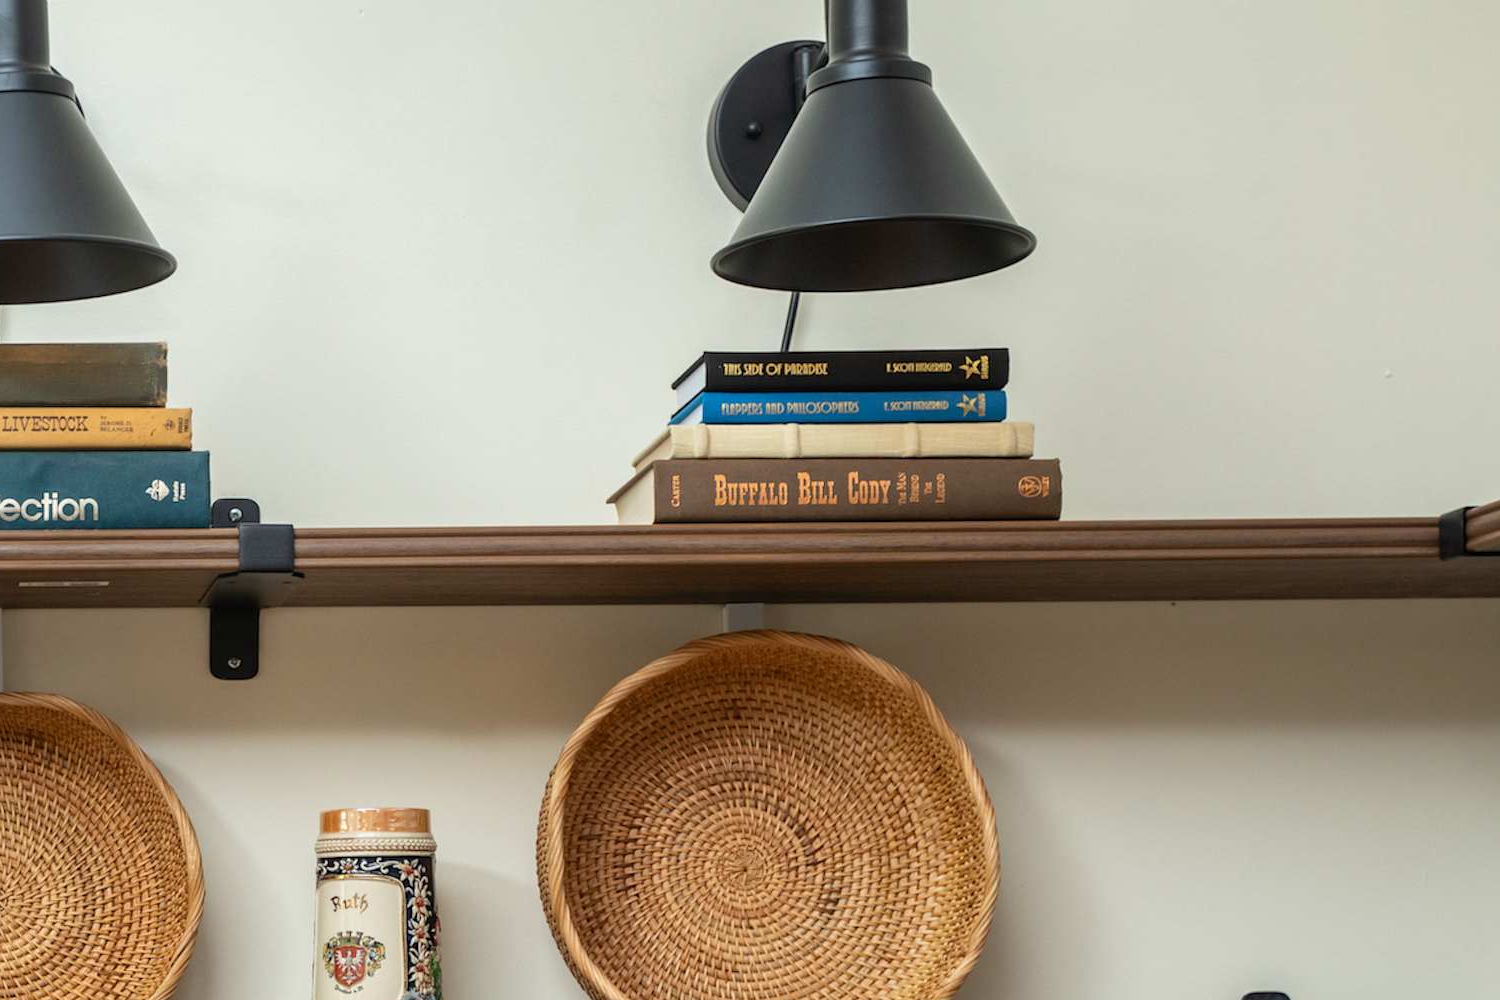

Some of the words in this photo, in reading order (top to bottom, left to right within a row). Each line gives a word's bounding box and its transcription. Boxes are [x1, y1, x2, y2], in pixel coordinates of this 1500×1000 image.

[743, 362, 764, 376] SIDE
[765, 362, 782, 376] OF
[765, 402, 785, 415] AND
[2, 415, 90, 433] LIVESTOCK
[671, 474, 680, 508] CARTER
[714, 474, 788, 506] BUFFALO
[797, 471, 837, 504] BILL
[847, 471, 892, 504] CODY
[330, 893, 369, 914] Ruth
